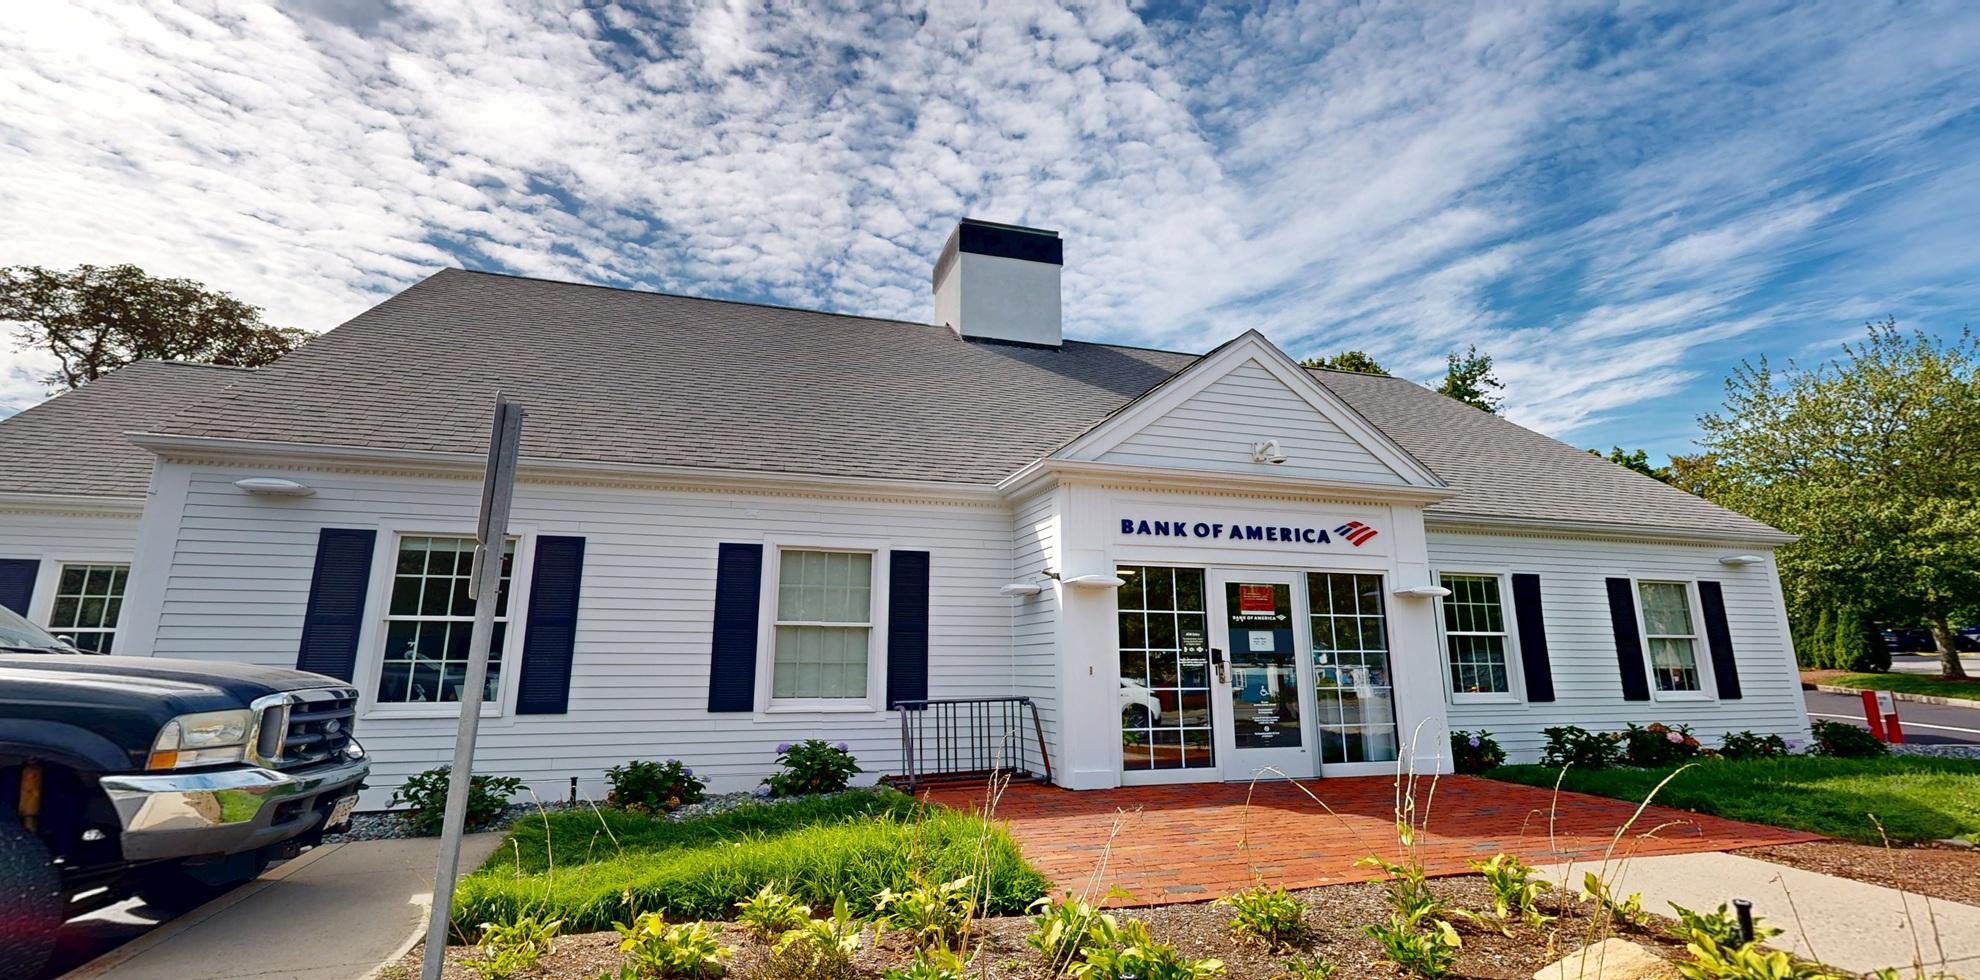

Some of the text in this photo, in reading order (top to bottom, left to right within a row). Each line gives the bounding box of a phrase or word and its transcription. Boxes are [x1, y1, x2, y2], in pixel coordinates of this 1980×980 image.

[1121, 519, 1331, 544] BANK OF AMERICA
